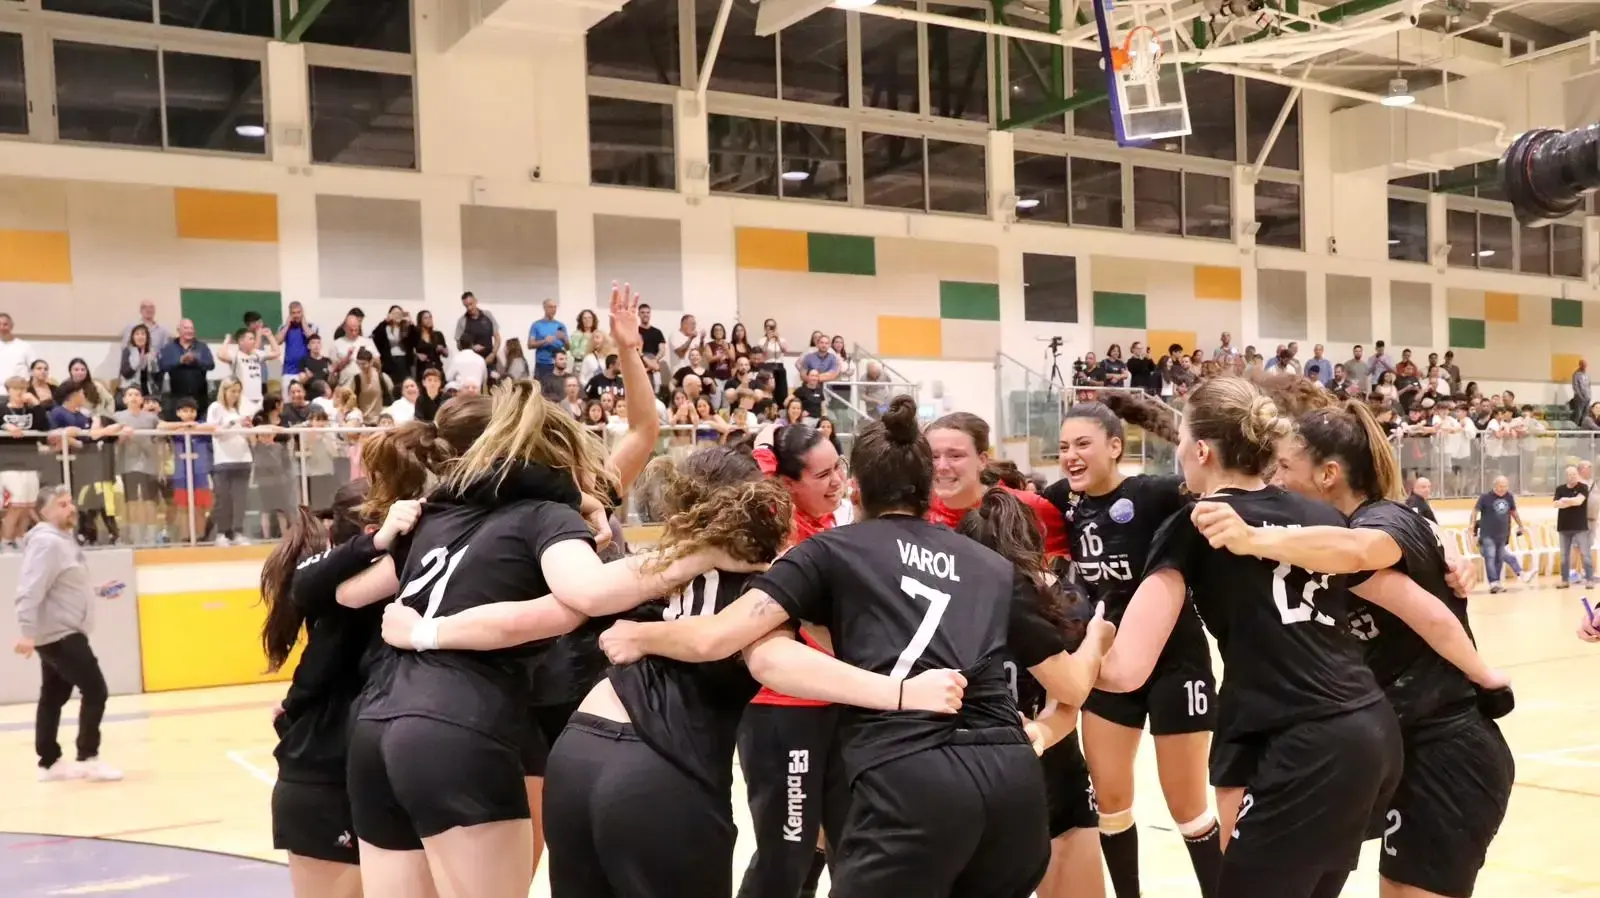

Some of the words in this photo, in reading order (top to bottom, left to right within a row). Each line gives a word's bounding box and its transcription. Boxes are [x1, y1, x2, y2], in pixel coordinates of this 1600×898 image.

[897, 538, 960, 582] VAROL
[1080, 522, 1103, 557] 16
[394, 544, 469, 618] 21
[890, 575, 951, 680] 7
[1183, 679, 1208, 716] 16
[789, 749, 809, 773] 33
[783, 775, 807, 842] Kempa
[1383, 809, 1402, 856] 2
